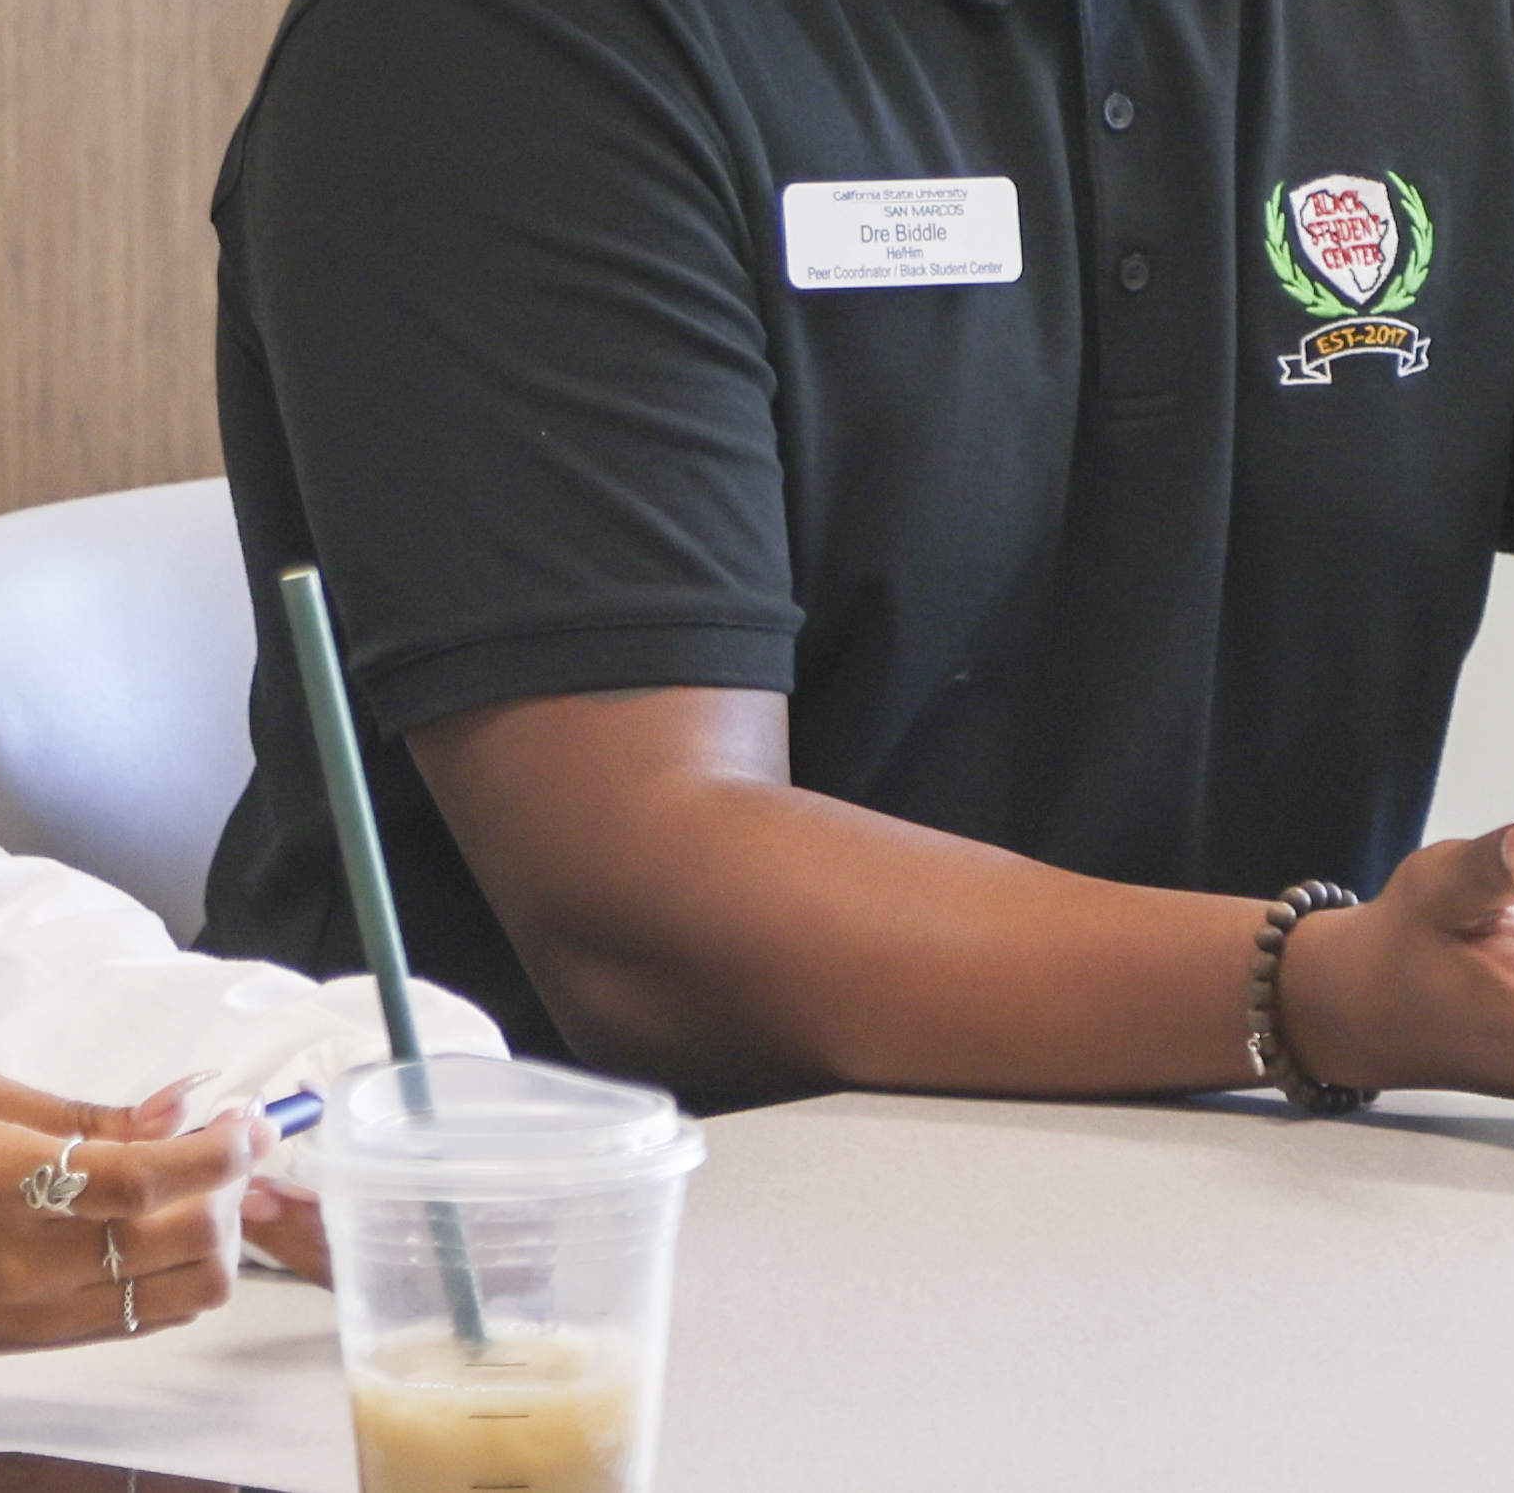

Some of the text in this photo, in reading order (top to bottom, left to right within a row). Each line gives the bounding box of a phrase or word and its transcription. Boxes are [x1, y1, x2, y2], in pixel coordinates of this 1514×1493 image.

[833, 188, 968, 202] California State University
[1311, 190, 1364, 217] BLACK
[884, 204, 964, 217] SAN MARCOS
[860, 223, 947, 243] Dre Biddle
[1306, 214, 1383, 246] STUDENT
[1322, 243, 1384, 270] CENTER
[807, 266, 831, 280] Peer
[833, 265, 891, 279] Coordinator
[900, 263, 926, 277] Black
[931, 262, 967, 276] Student
[969, 261, 1003, 275] Center
